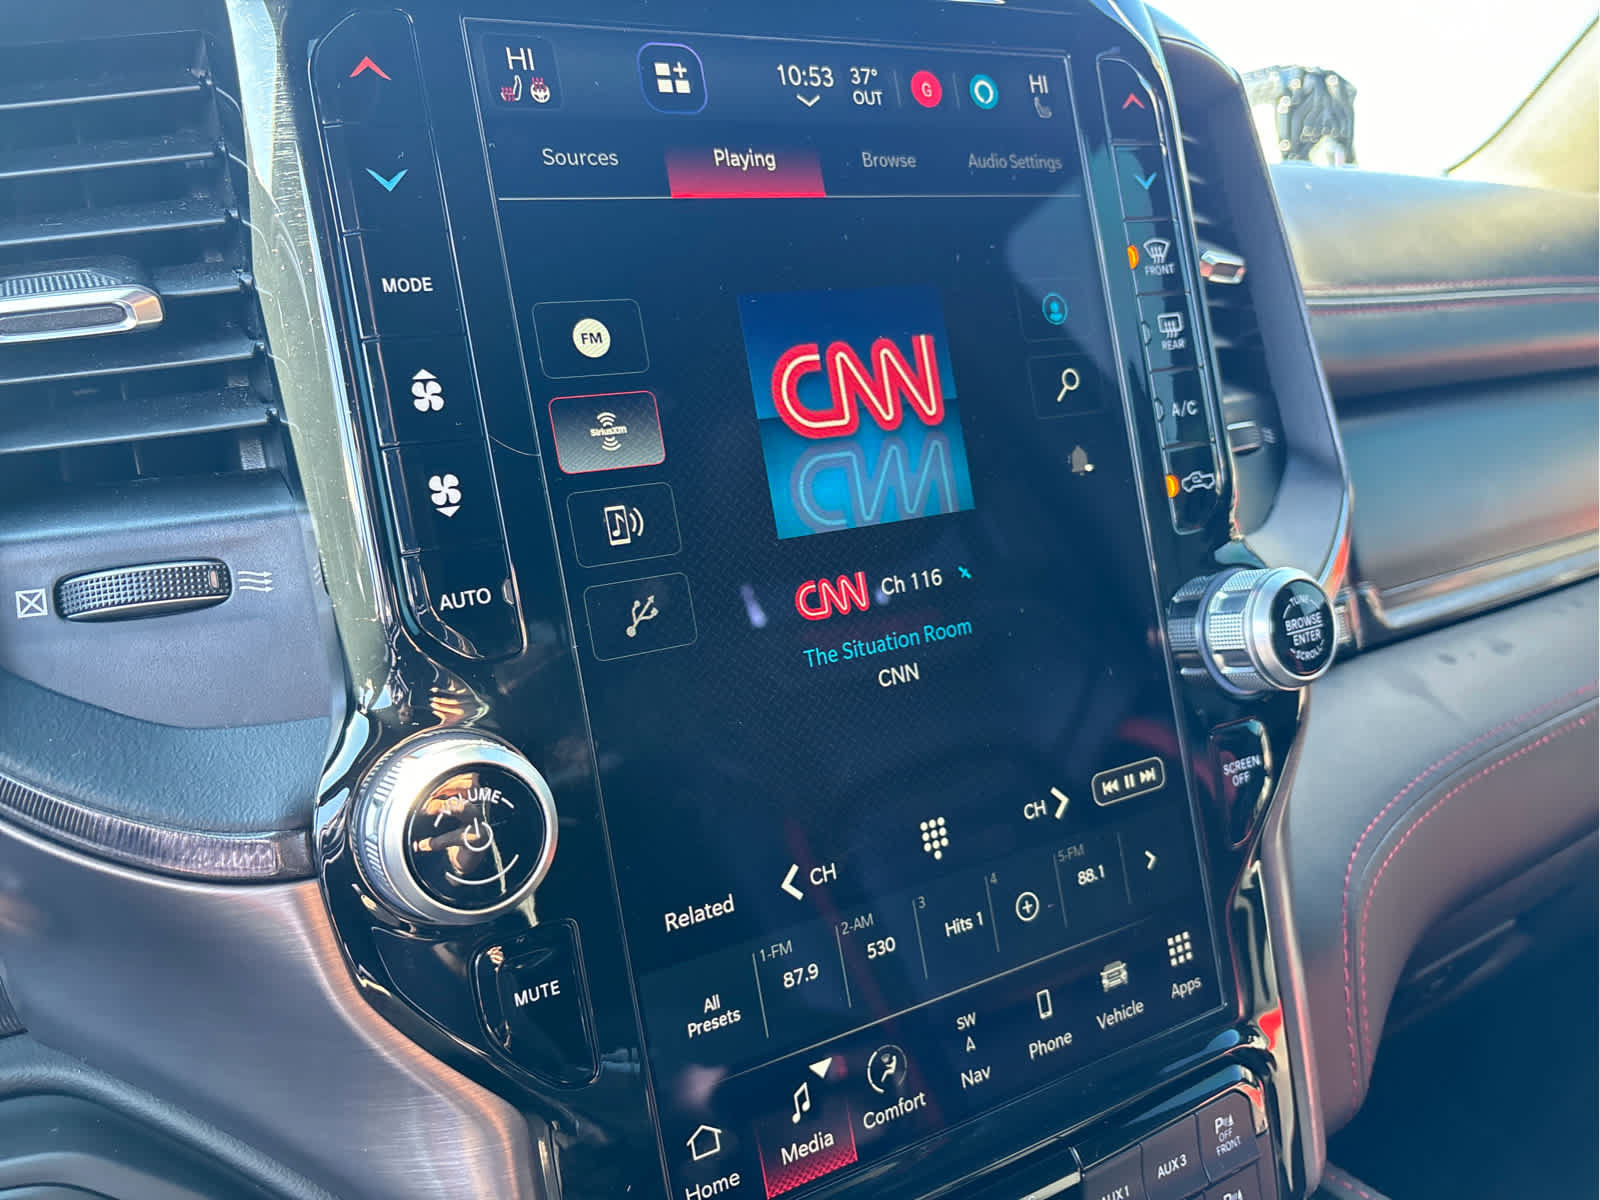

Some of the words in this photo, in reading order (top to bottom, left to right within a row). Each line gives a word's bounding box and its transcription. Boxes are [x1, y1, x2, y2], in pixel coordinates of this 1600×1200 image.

[506, 47, 536, 71] HI
[776, 64, 835, 89] 10:53
[849, 67, 878, 86] 37°
[1029, 74, 1049, 94] HI
[853, 90, 883, 106] OUT
[921, 82, 932, 98] G
[542, 148, 618, 167] Sources
[713, 147, 777, 172] Playing
[862, 151, 917, 169] Browse
[968, 153, 1007, 170] Audio
[1009, 153, 1063, 173] Settings
[1145, 263, 1175, 276] FRONT
[382, 277, 433, 294] MODE
[581, 331, 603, 346] FM
[1162, 339, 1185, 350] REAR
[771, 334, 946, 439] CNN
[1172, 400, 1197, 417] A/C
[439, 588, 491, 612] AUTO
[795, 571, 871, 621] CNN
[881, 575, 906, 596] Ch
[910, 569, 943, 590] 116
[1285, 612, 1323, 632] BROWSE
[803, 647, 838, 669] The
[843, 630, 921, 661] Situation
[923, 619, 973, 643] Room
[1292, 629, 1321, 646] ENTER
[1296, 645, 1323, 661] SCROLL
[877, 662, 921, 689] CNN
[1223, 755, 1261, 777] SCREEN
[1232, 770, 1250, 787] OFF
[1023, 799, 1047, 820] CH
[1057, 842, 1085, 863] 5-FM
[809, 862, 837, 886] CH
[989, 872, 997, 886] 4
[1077, 864, 1105, 887] 88.1
[664, 894, 736, 933] Related
[918, 896, 927, 909] 3
[841, 912, 874, 936] 2-AM
[944, 914, 975, 938] Hits
[759, 940, 793, 963] 1-FM
[866, 936, 897, 961] 530
[782, 963, 820, 990] 87.9
[513, 980, 561, 1007] MUTE
[1170, 975, 1202, 1001] Apps
[703, 993, 720, 1014] All
[687, 1007, 742, 1039] Presets
[956, 1012, 977, 1032] SW
[1095, 1000, 1146, 1032] Vehicle
[1028, 1030, 1073, 1061] Phone
[960, 1065, 992, 1089] Nav
[862, 1091, 928, 1131] Comfort
[1216, 1135, 1241, 1156] FRONT
[1218, 1128, 1233, 1143] OFF
[780, 1130, 835, 1167] Media
[685, 1172, 741, 1200] Home
